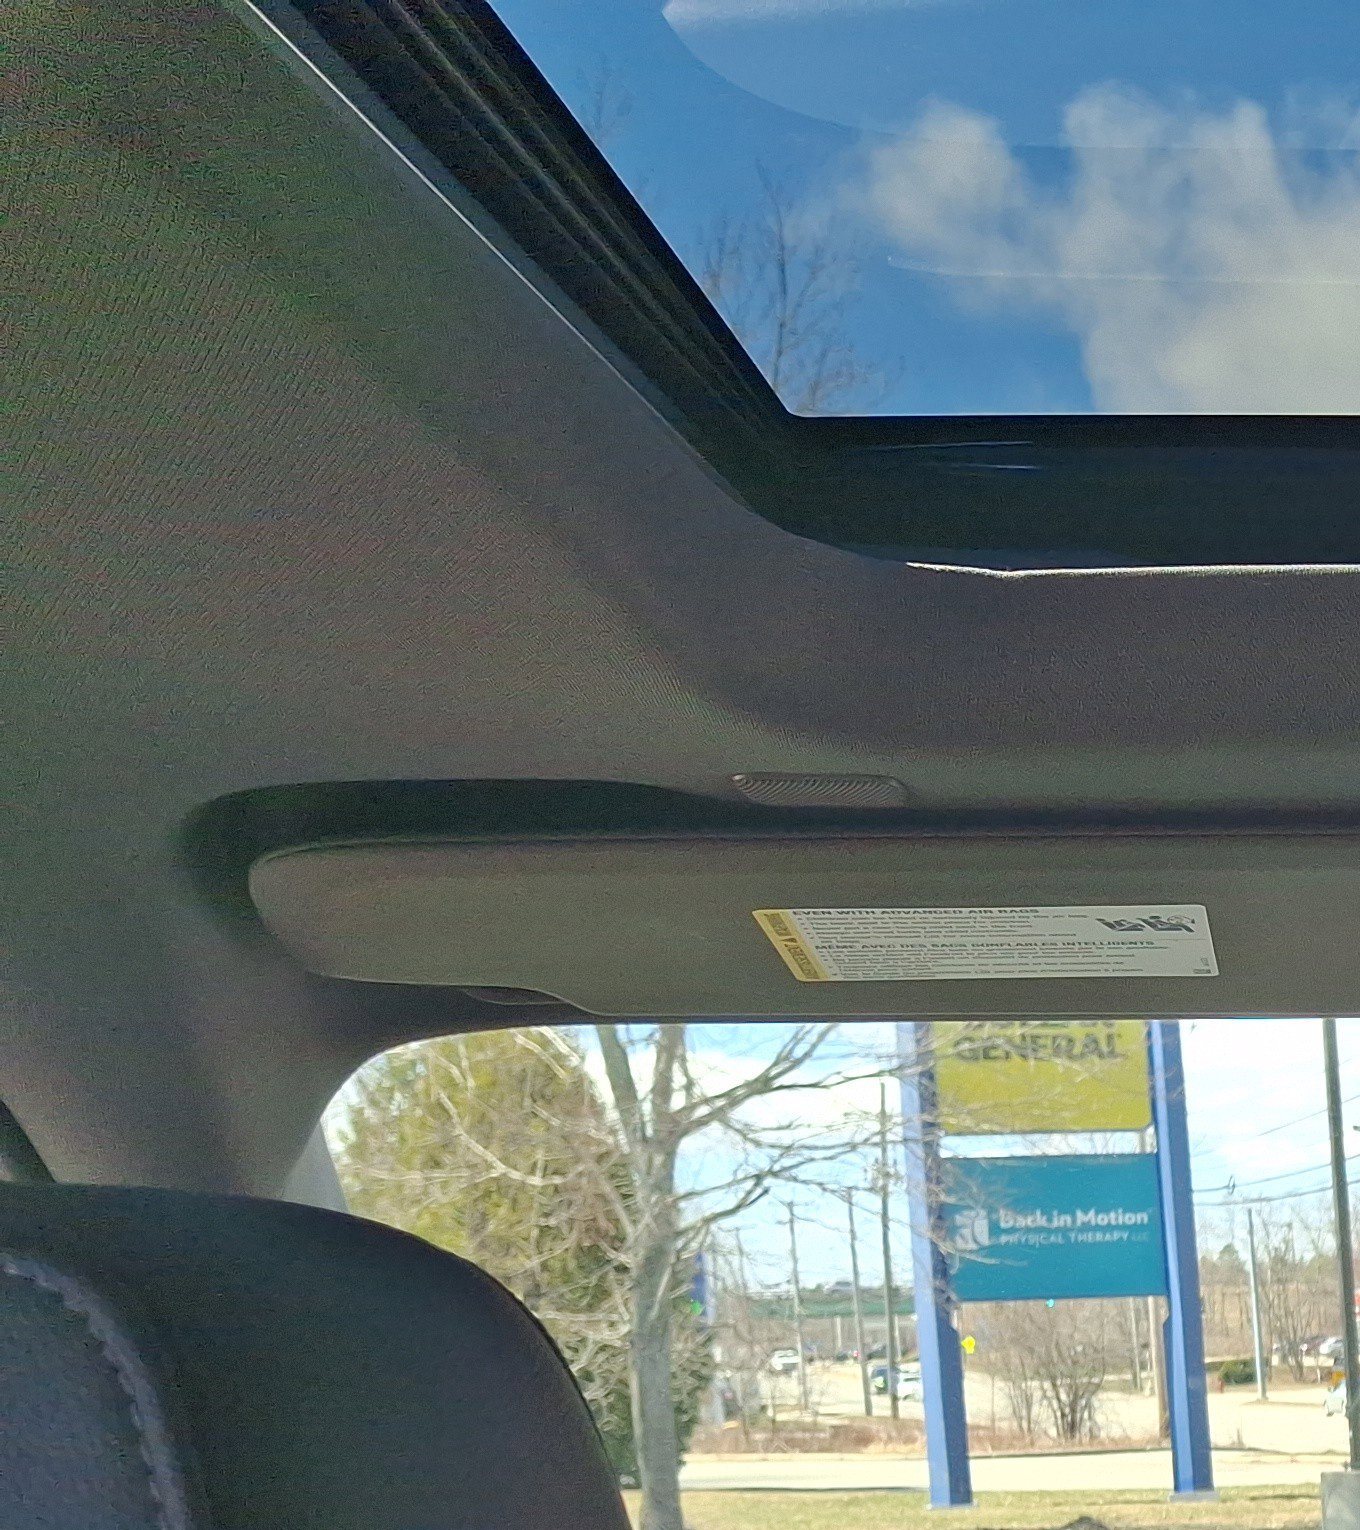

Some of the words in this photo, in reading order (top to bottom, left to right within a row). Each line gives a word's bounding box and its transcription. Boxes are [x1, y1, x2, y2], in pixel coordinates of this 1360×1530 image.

[953, 1033, 1124, 1062] GENERAL
[1000, 1209, 1045, 1229] Back
[1052, 1209, 1074, 1228] in
[1076, 1208, 1149, 1227] Motion
[1000, 1232, 1065, 1246] PHYSICAL
[1069, 1231, 1131, 1244] THERAPY
